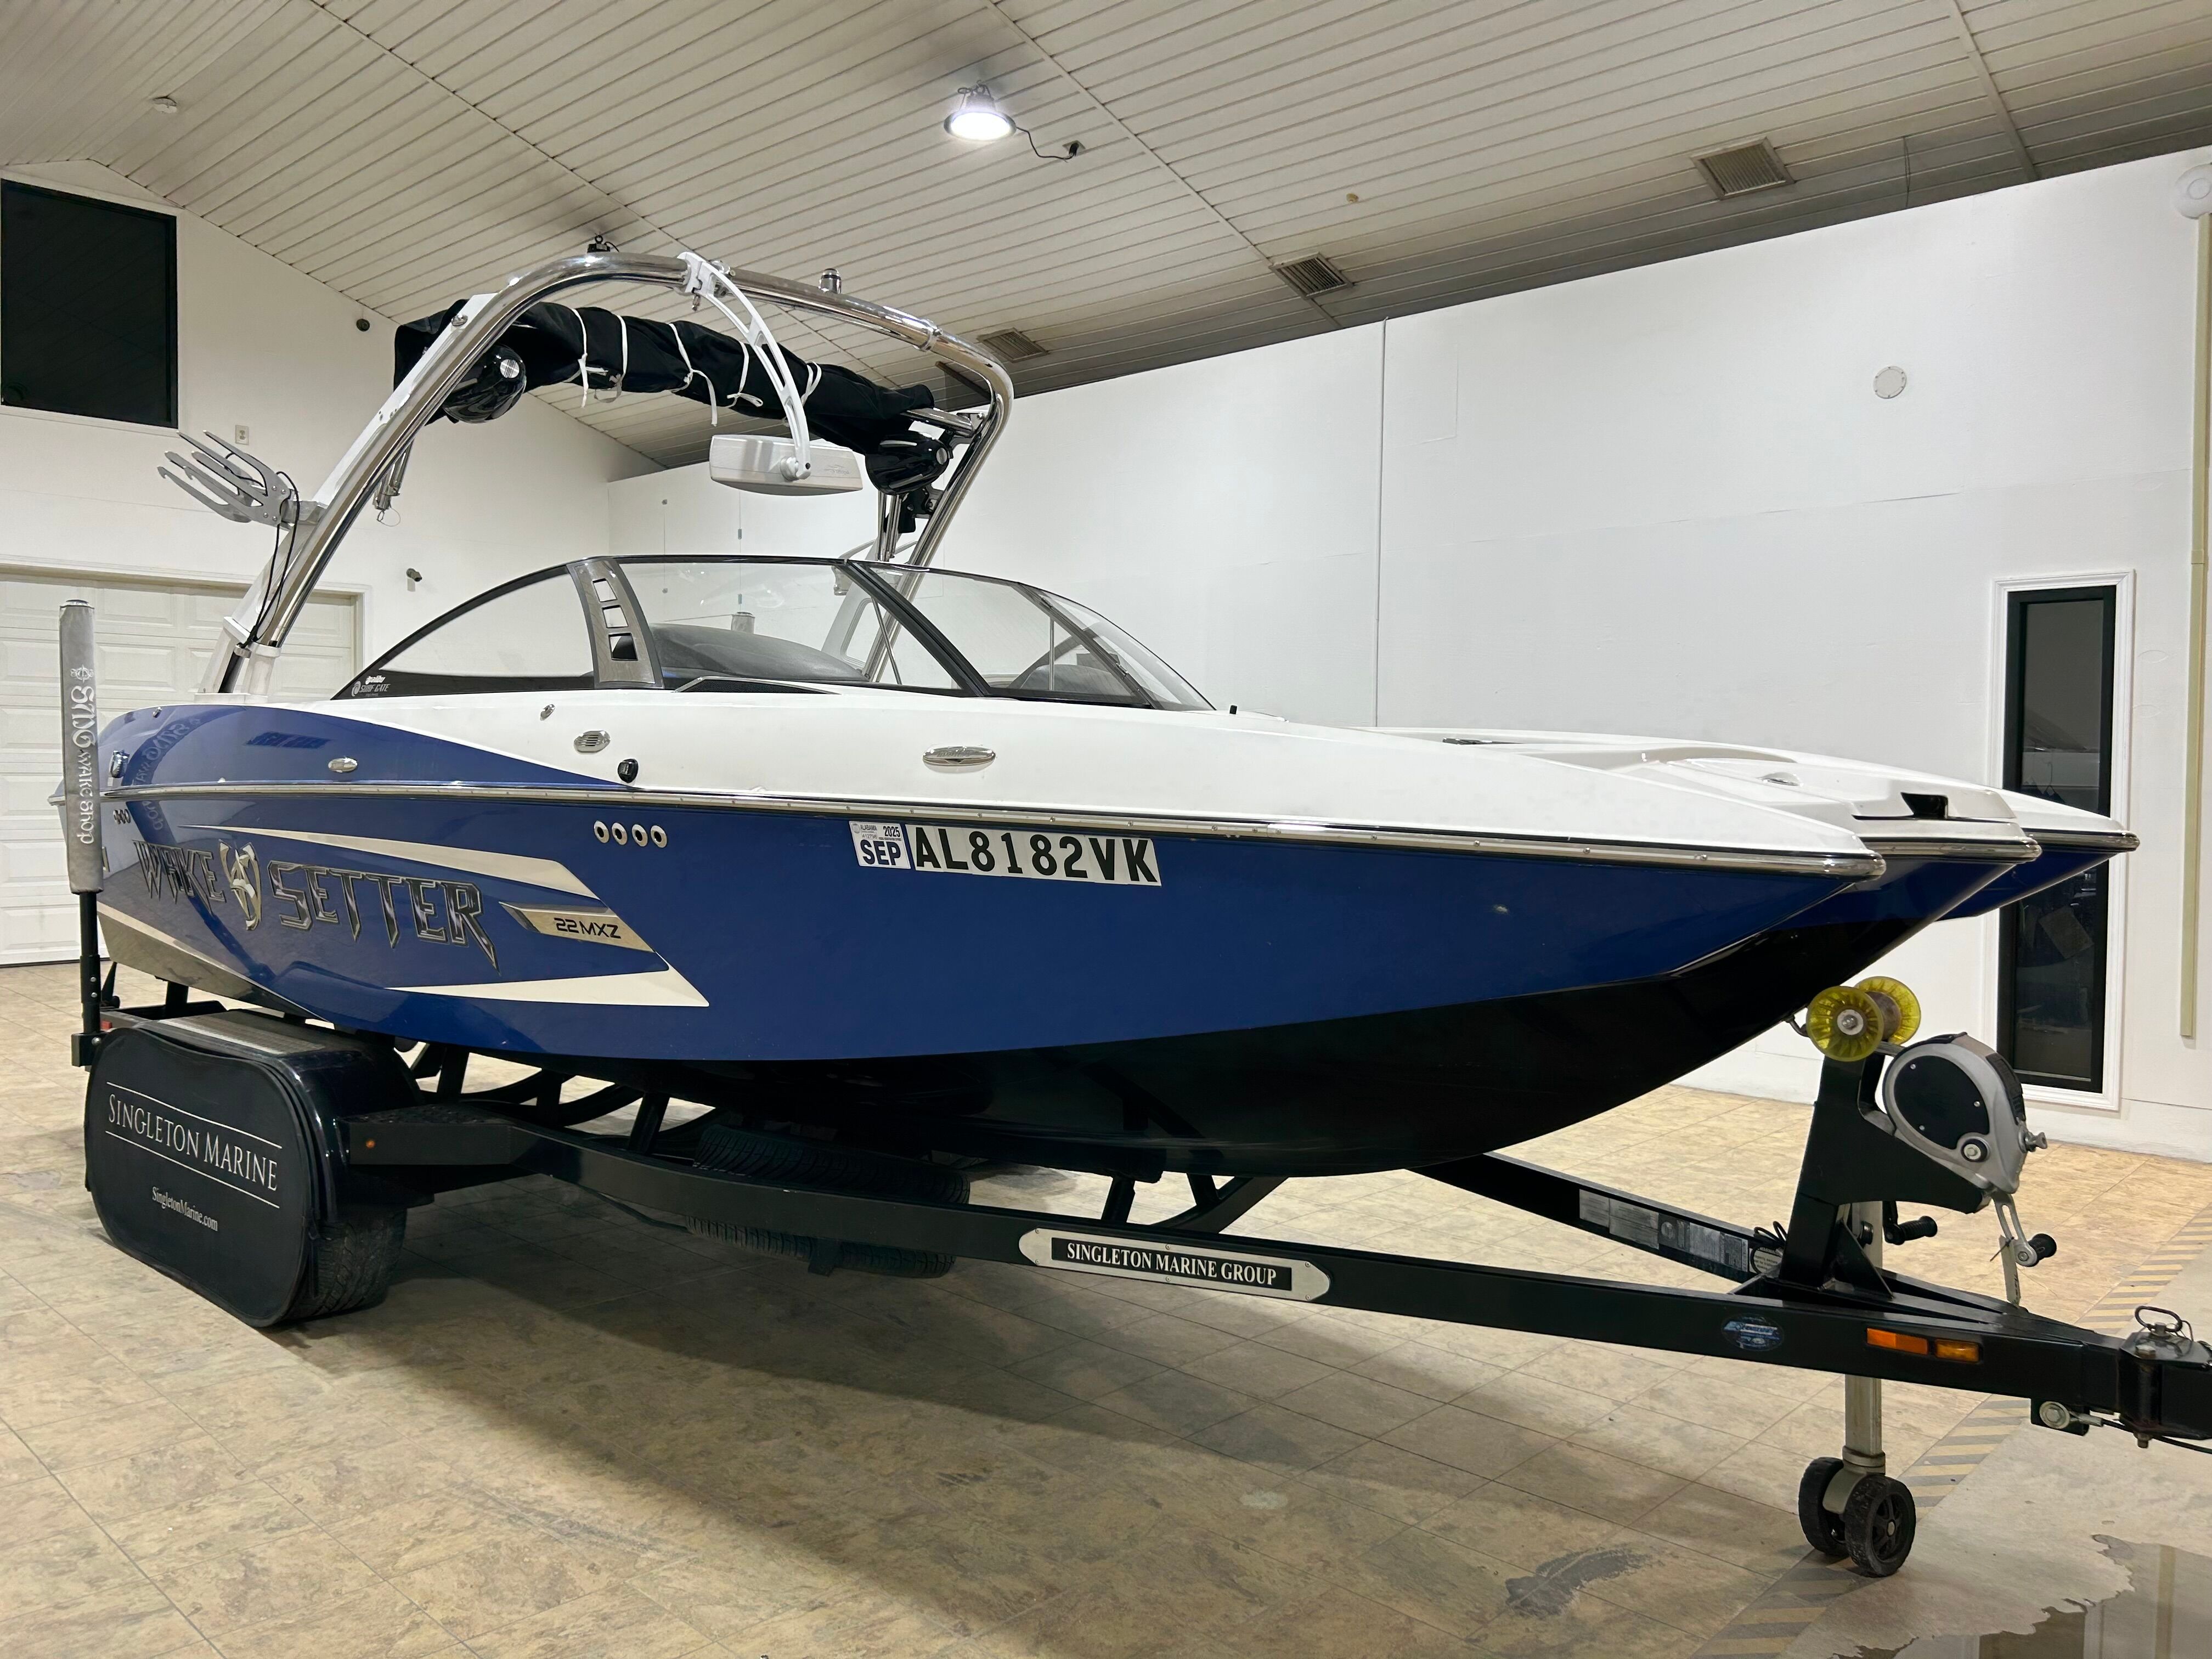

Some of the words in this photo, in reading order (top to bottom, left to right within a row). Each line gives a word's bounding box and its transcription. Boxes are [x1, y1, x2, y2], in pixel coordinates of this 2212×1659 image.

[860, 839, 901, 865] SEP
[883, 826, 900, 837] 2025
[916, 827, 1158, 882] AL8182VK
[132, 839, 227, 913] WAKE
[267, 859, 501, 975] SETTER
[109, 1094, 200, 1159] SINGLETON
[204, 1132, 278, 1191] MARINE
[152, 1186, 218, 1232] SingletonMarine.com
[1067, 1242, 1152, 1269] SINGLETON
[1155, 1254, 1217, 1278] MARINE
[1221, 1262, 1277, 1285] GROUP
